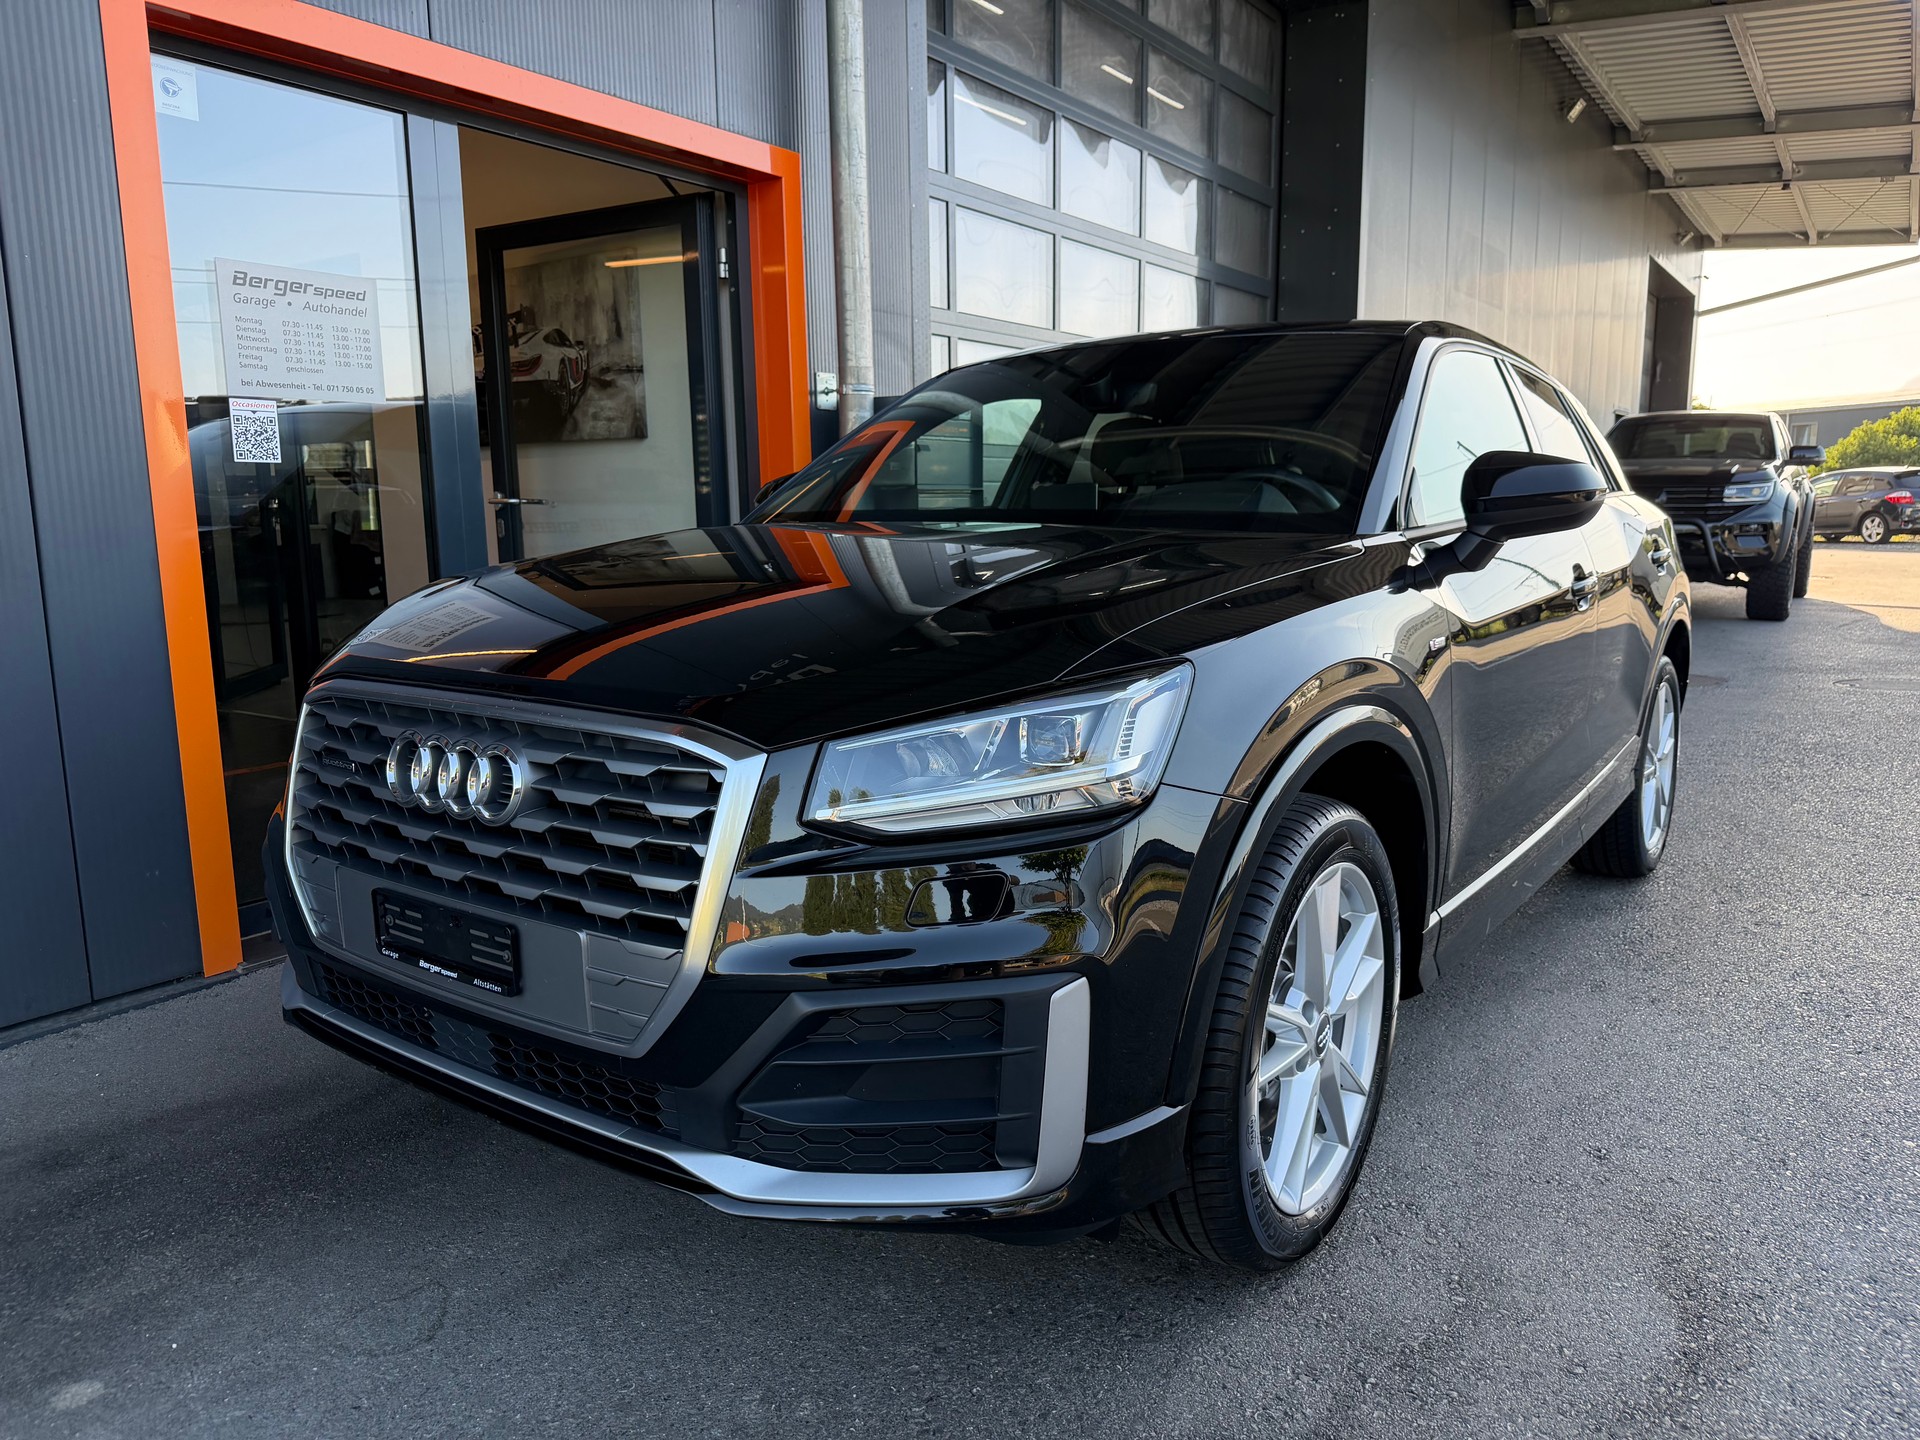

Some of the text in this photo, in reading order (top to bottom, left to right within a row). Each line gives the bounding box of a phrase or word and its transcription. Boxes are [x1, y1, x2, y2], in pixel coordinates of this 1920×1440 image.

[232, 270, 367, 302] Bergerspeed
[233, 292, 368, 318] Garage Autohandel
[235, 315, 263, 326] Montag
[282, 320, 300, 328] 07.30
[306, 323, 323, 331] 11.45
[332, 325, 349, 333] 13.00
[236, 324, 266, 335] Dienstag
[282, 329, 301, 337] 07.30
[355, 336, 371, 344] 17.00
[237, 334, 270, 343] Mittwoch
[283, 338, 301, 346] 07.30
[308, 340, 325, 348] 11.45
[238, 343, 278, 354] Donnerstag
[285, 347, 303, 355] 07.30
[309, 349, 326, 357] 11.45
[357, 353, 372, 361] 17.00
[238, 352, 263, 363] Freitag
[285, 356, 304, 364] 07.30
[310, 358, 327, 366] 11.45
[335, 360, 351, 368] 13.00
[357, 362, 373, 370] 15.00
[239, 361, 324, 374] Samstag geschlossen
[241, 378, 254, 387] bei
[255, 379, 306, 390] Abwesenheit
[312, 383, 325, 392] Tel.
[326, 384, 340, 392] 071
[341, 385, 355, 394] 750
[355, 386, 365, 394] 05
[365, 387, 375, 395] 05
[232, 400, 275, 409] Occasionen
[381, 947, 399, 959] Garage
[473, 978, 502, 993] Altstätten
